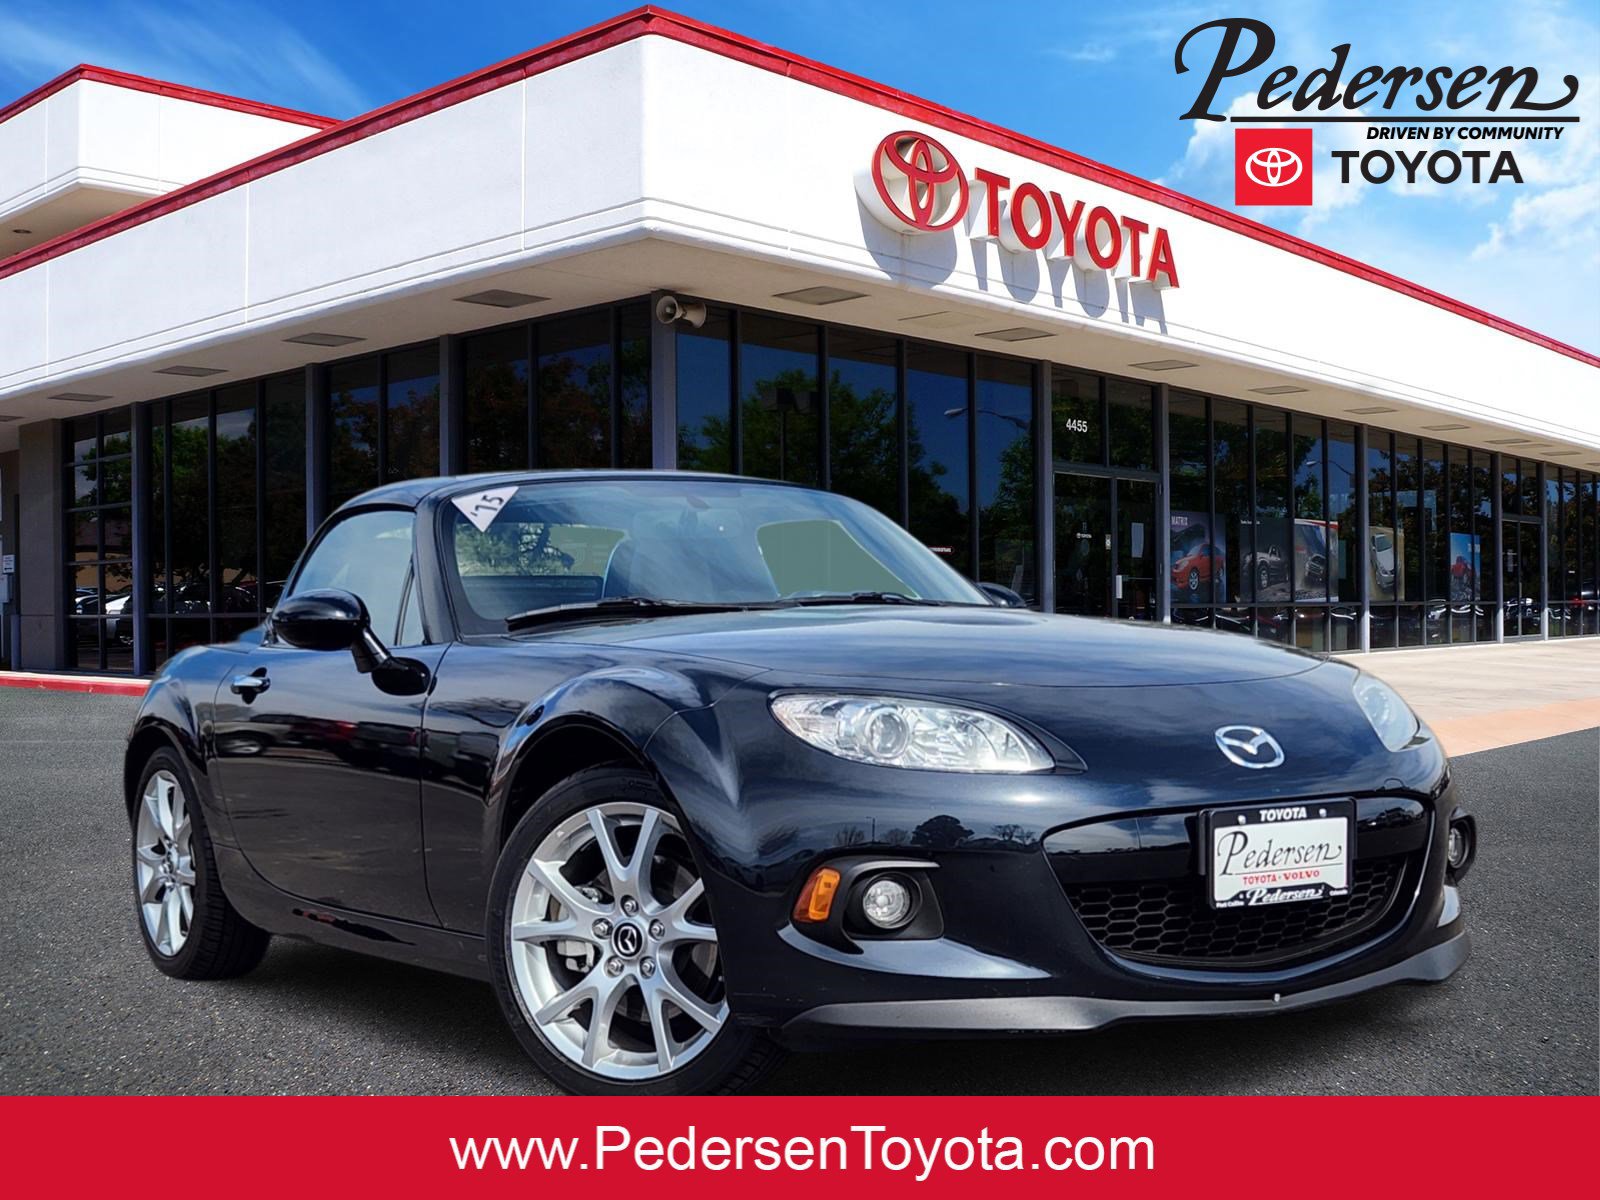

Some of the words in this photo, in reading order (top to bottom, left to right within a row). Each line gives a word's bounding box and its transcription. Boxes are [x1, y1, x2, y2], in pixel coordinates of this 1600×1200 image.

[975, 167, 1179, 289] TOYOTA
[1065, 418, 1088, 433] 4455
[1259, 807, 1307, 822] TOYOTA
[1217, 830, 1342, 876] Pedersen
[1242, 872, 1277, 885] TOYOTA
[1283, 869, 1320, 881] VOLVO
[1246, 887, 1325, 906] Pedersen
